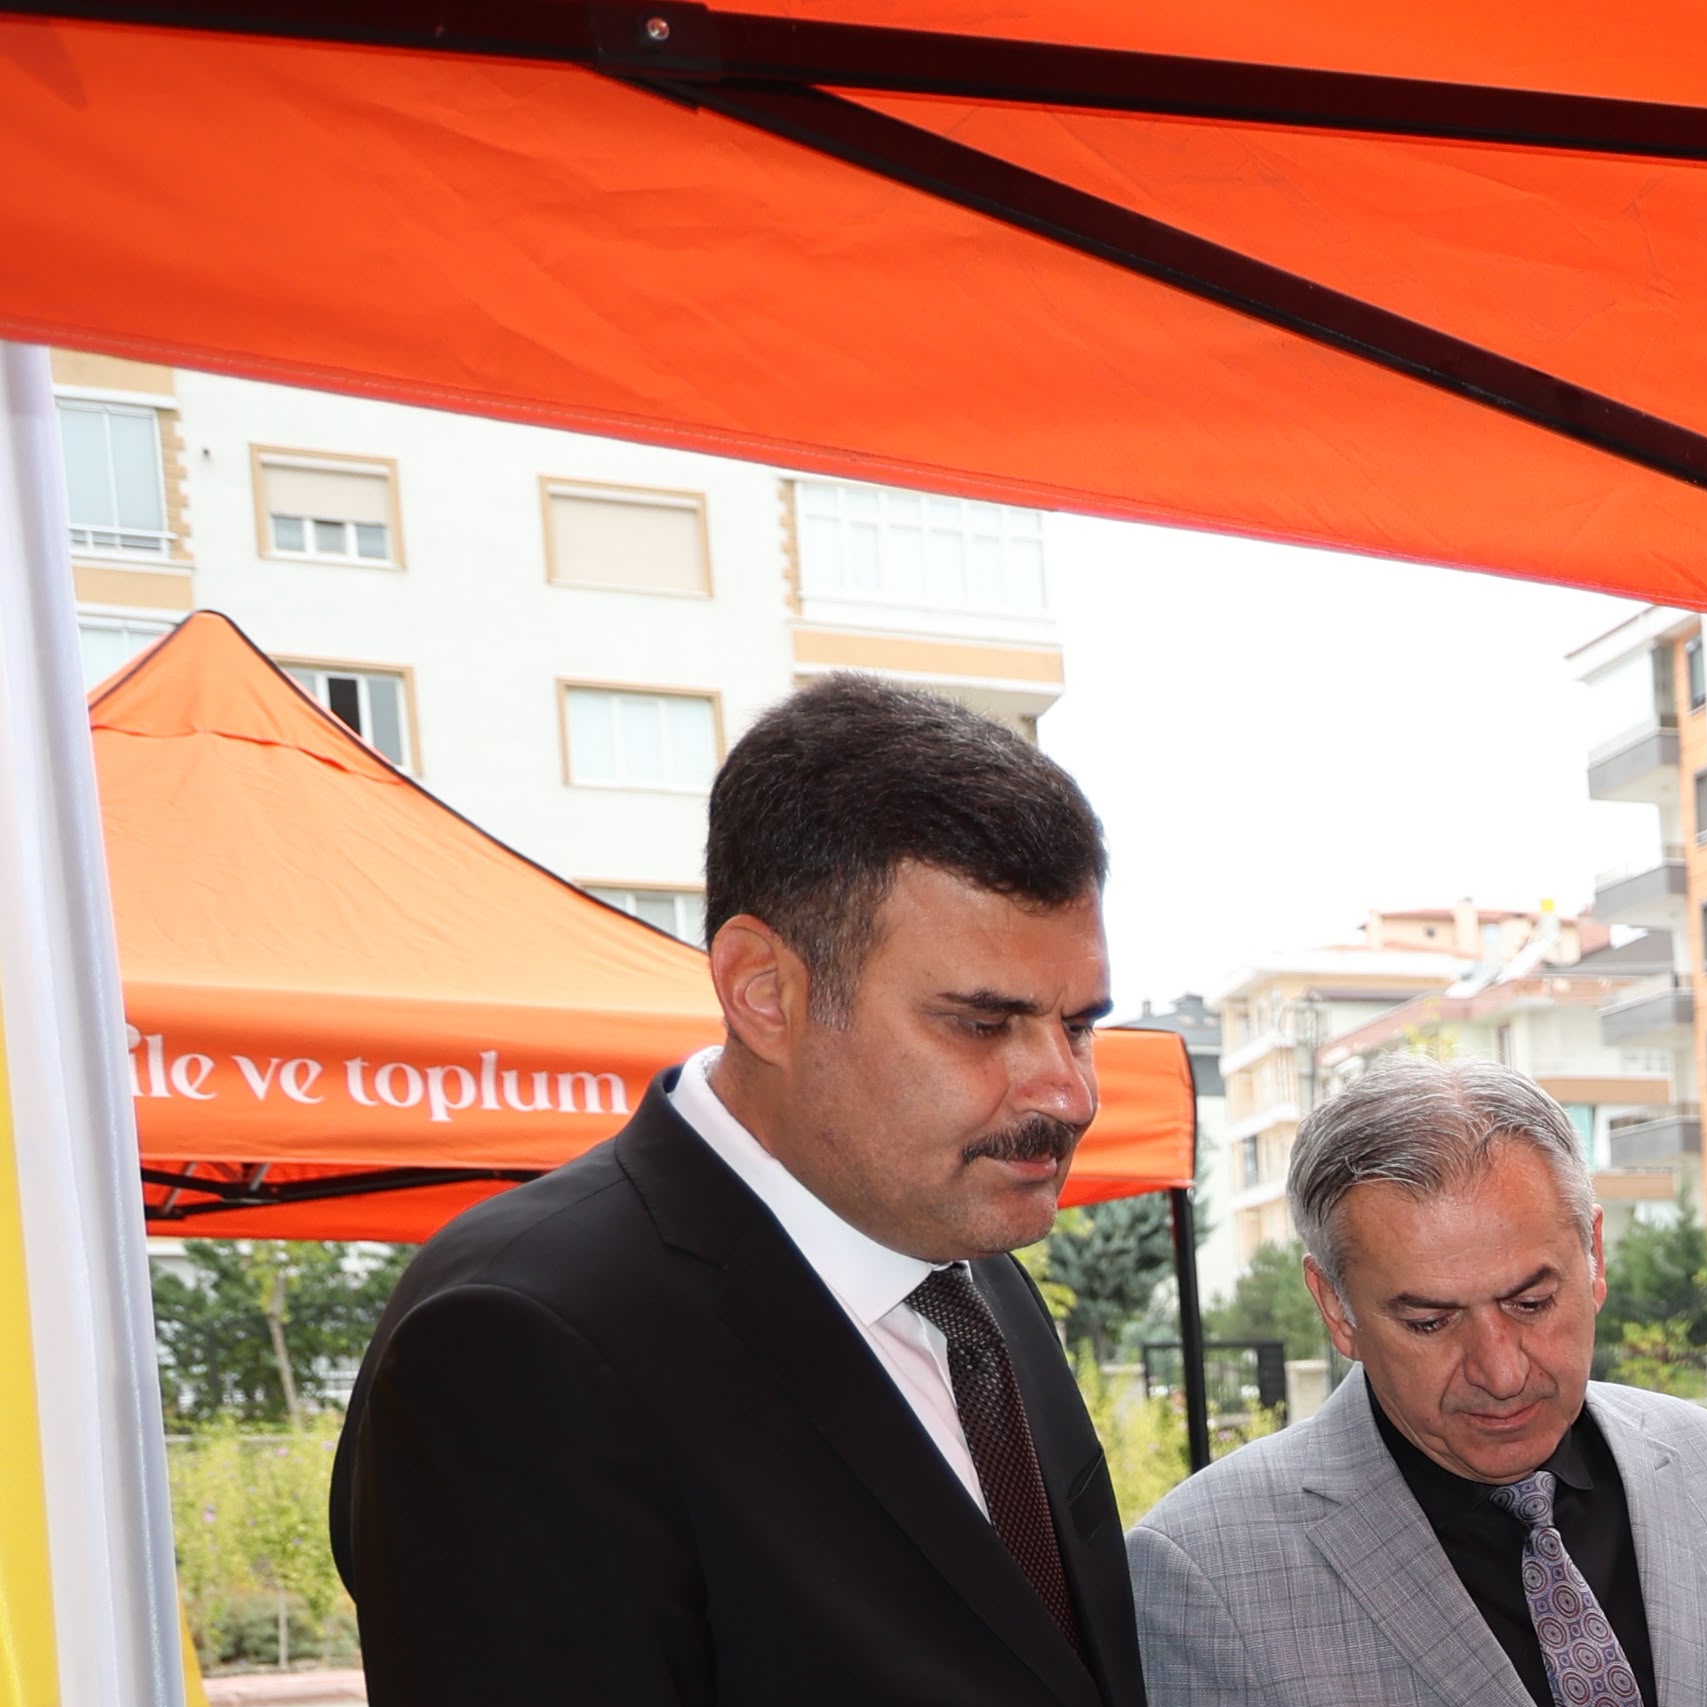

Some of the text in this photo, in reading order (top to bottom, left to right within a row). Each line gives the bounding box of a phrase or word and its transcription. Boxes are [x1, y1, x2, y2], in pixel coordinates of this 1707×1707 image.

[126, 1023, 629, 1122] ile ve toplum
